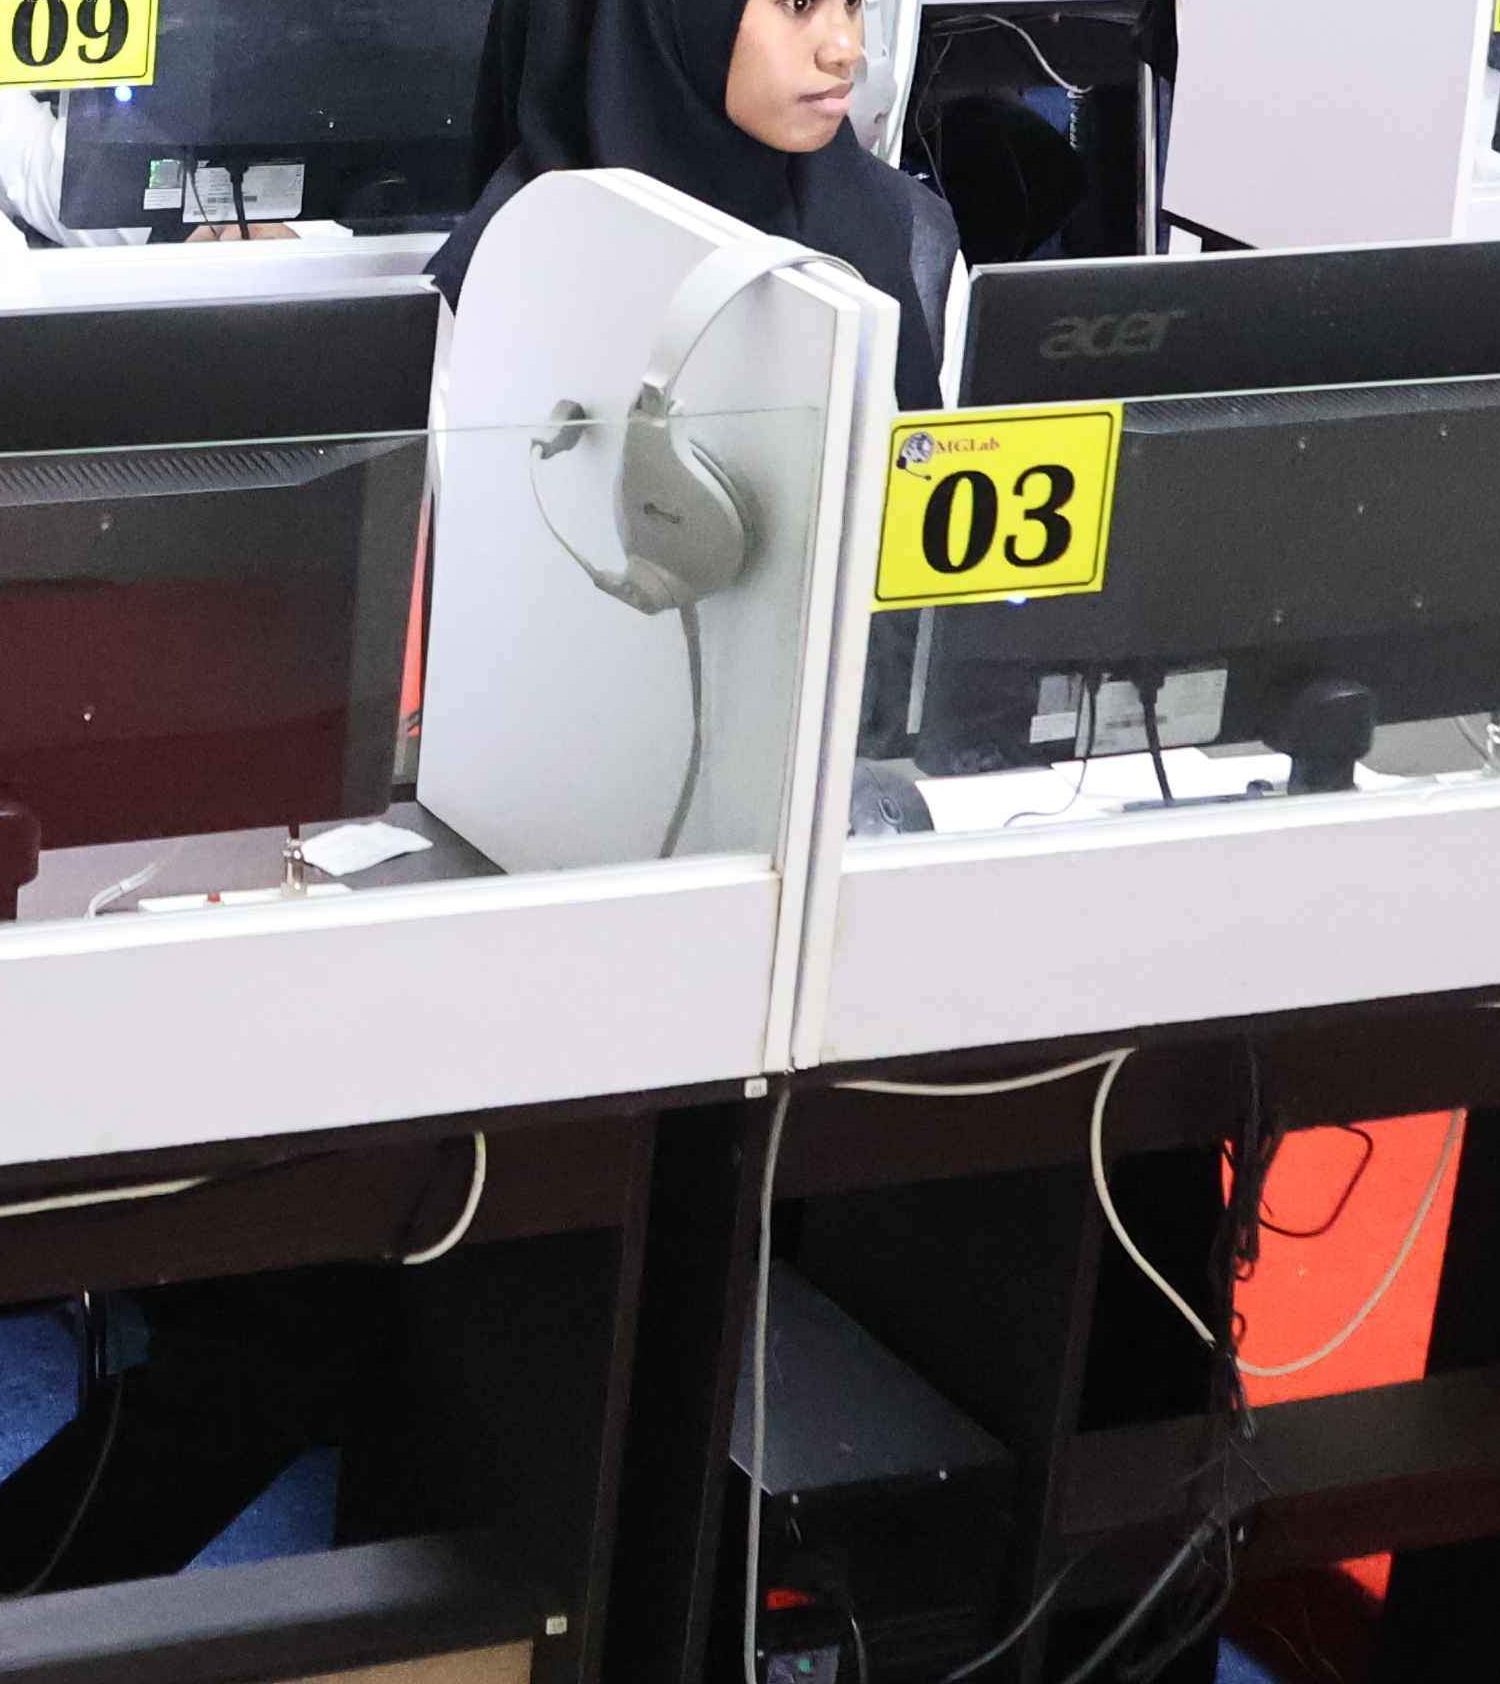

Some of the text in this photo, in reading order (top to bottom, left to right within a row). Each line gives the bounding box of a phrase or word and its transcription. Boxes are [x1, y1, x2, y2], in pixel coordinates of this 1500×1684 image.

[1038, 308, 1186, 360] acer
[934, 436, 1001, 454] MGLab
[920, 463, 1077, 574] 03
